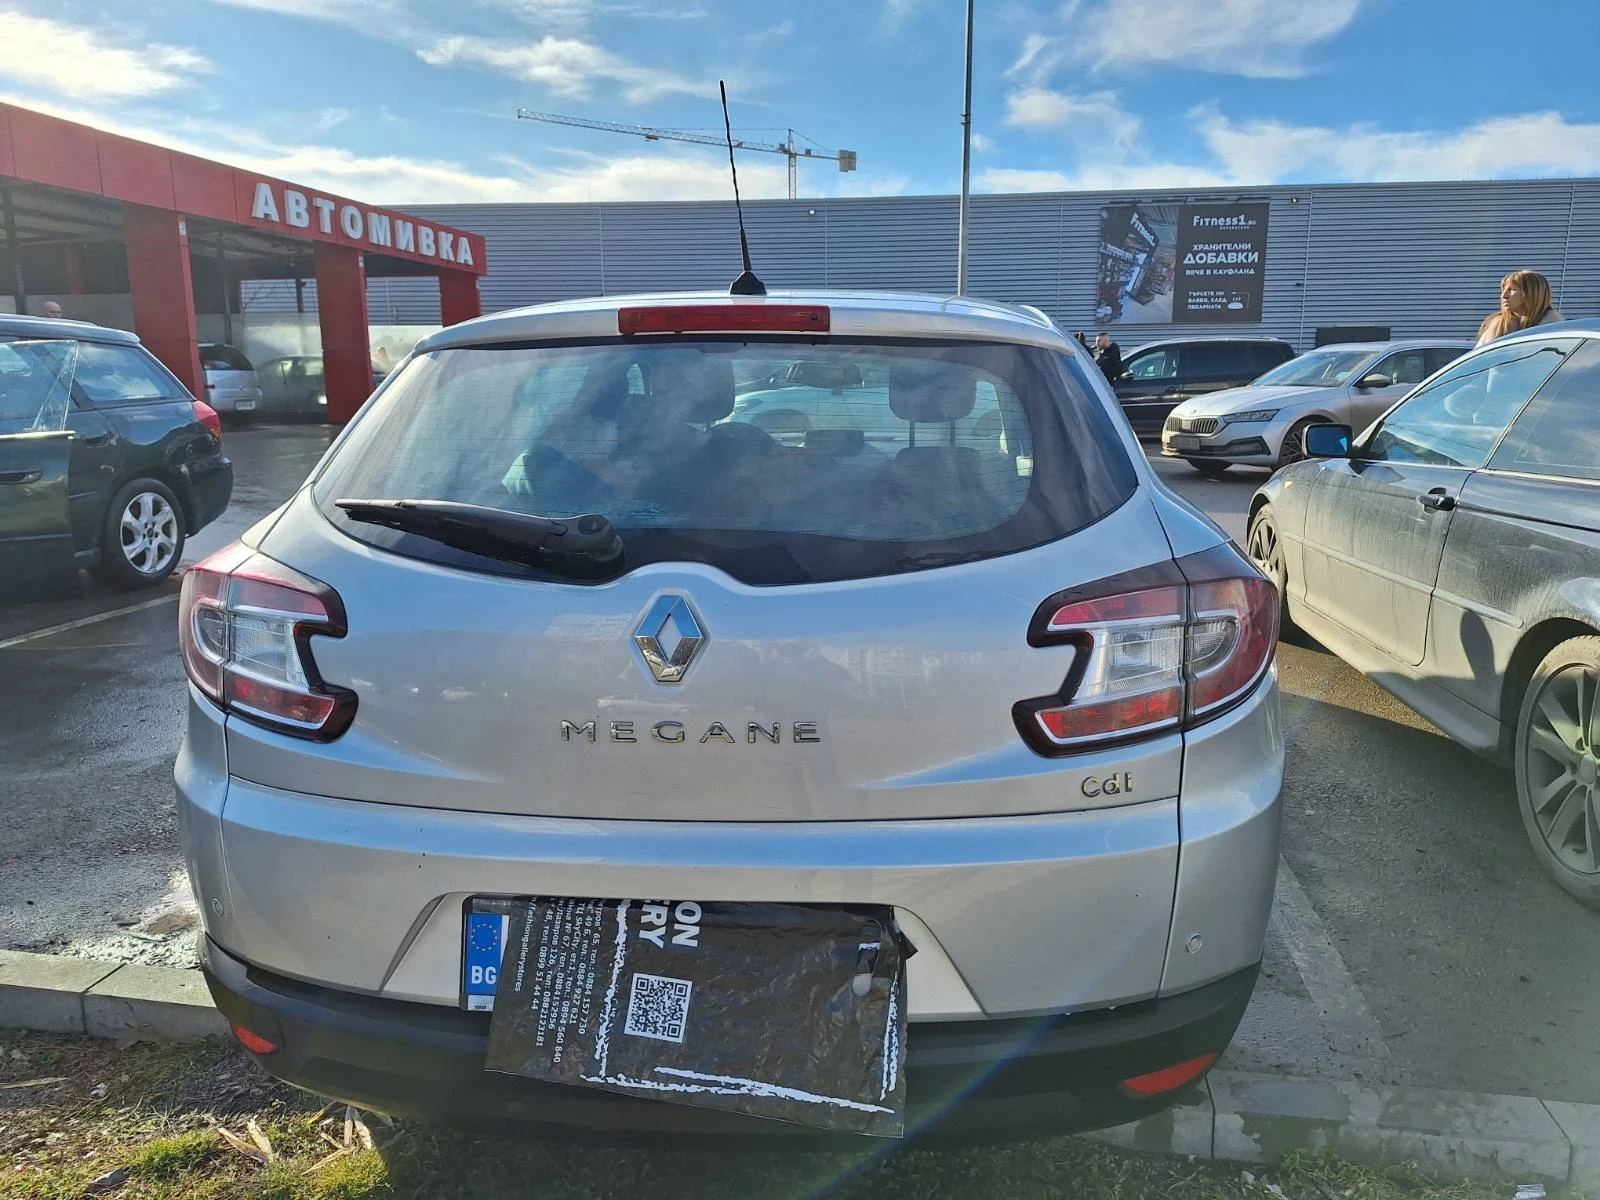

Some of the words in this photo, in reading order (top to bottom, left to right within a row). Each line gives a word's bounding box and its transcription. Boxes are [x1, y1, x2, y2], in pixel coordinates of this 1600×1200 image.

[252, 182, 474, 266] АВТОМИВКА
[1183, 251, 1259, 264] ДОБАВКИ
[1192, 243, 1252, 251] ХРАНИТЕЛНИ
[561, 719, 820, 744] MEGANE
[639, 899, 671, 949] RY
[471, 965, 497, 985] BG
